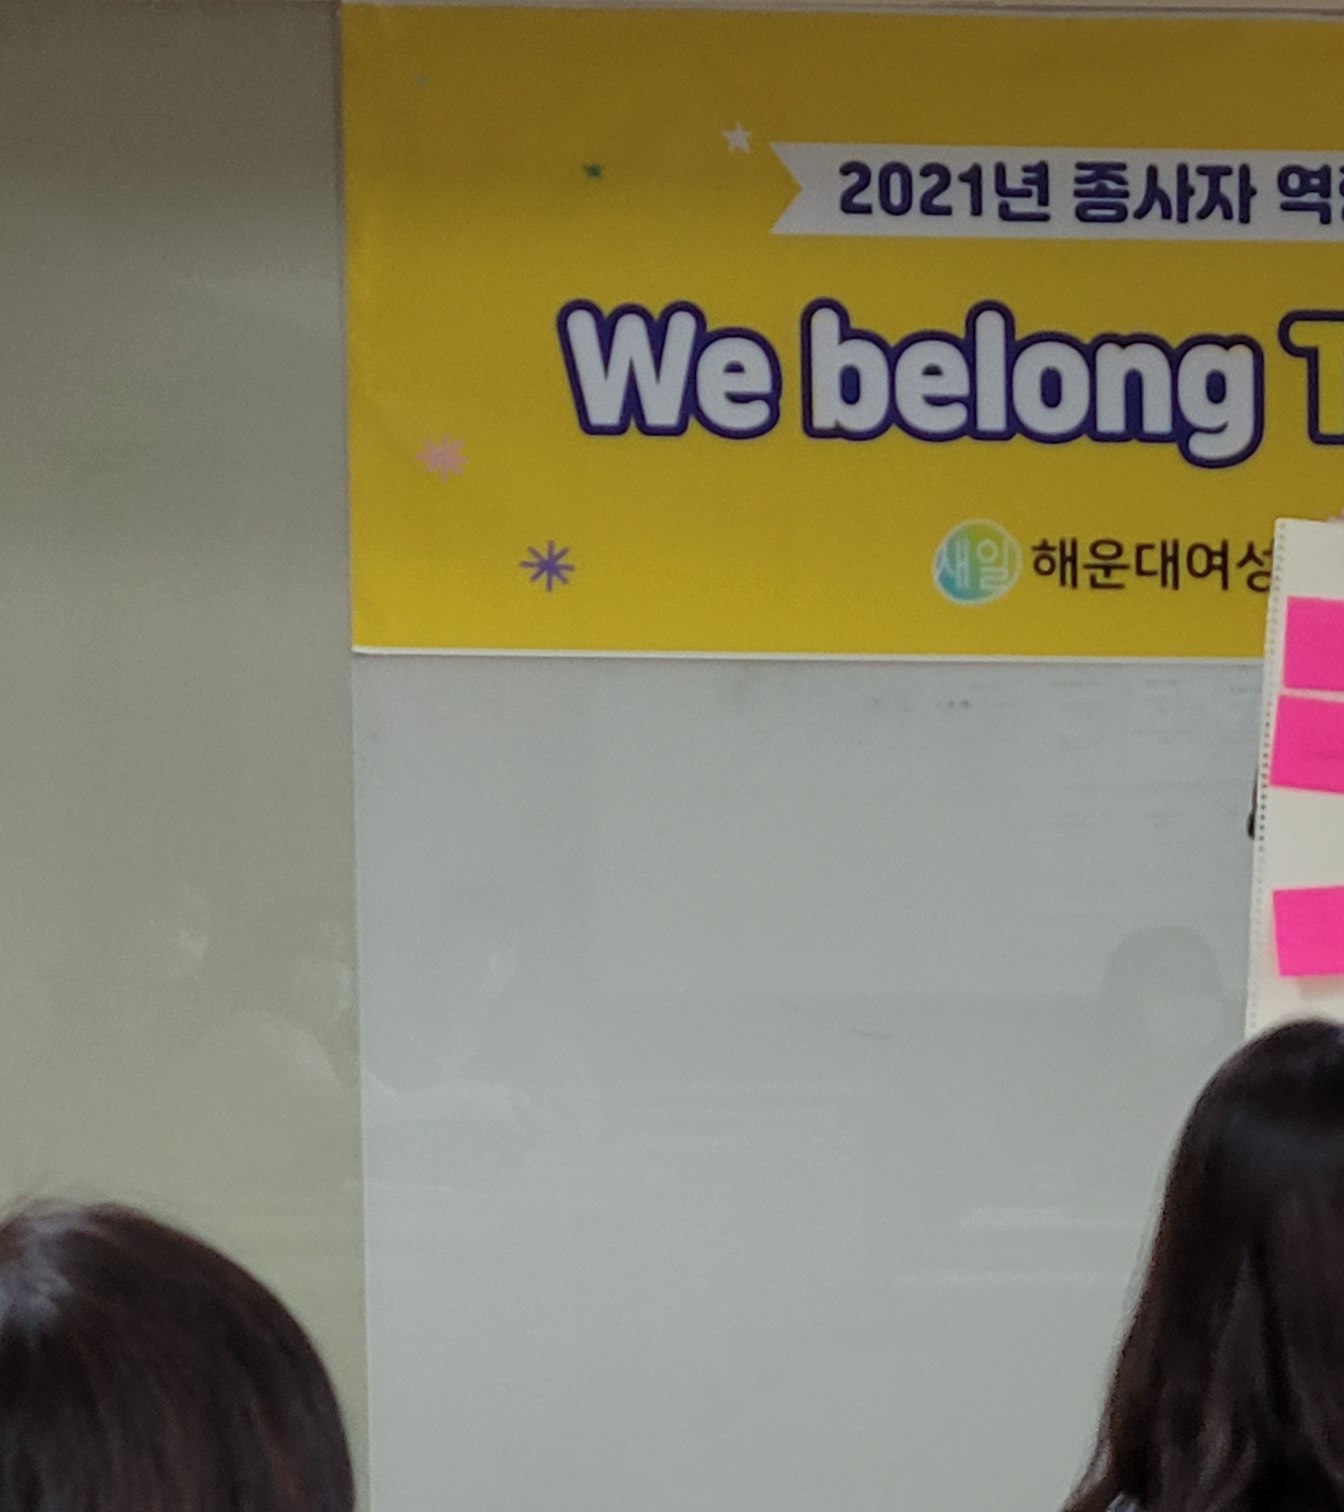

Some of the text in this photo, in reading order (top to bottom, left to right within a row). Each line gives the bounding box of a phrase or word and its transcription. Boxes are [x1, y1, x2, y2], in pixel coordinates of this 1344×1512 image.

[838, 160, 1052, 223] 2021년
[1073, 161, 1257, 225] 종사자
[557, 298, 782, 439] We
[801, 297, 1264, 468] belong
